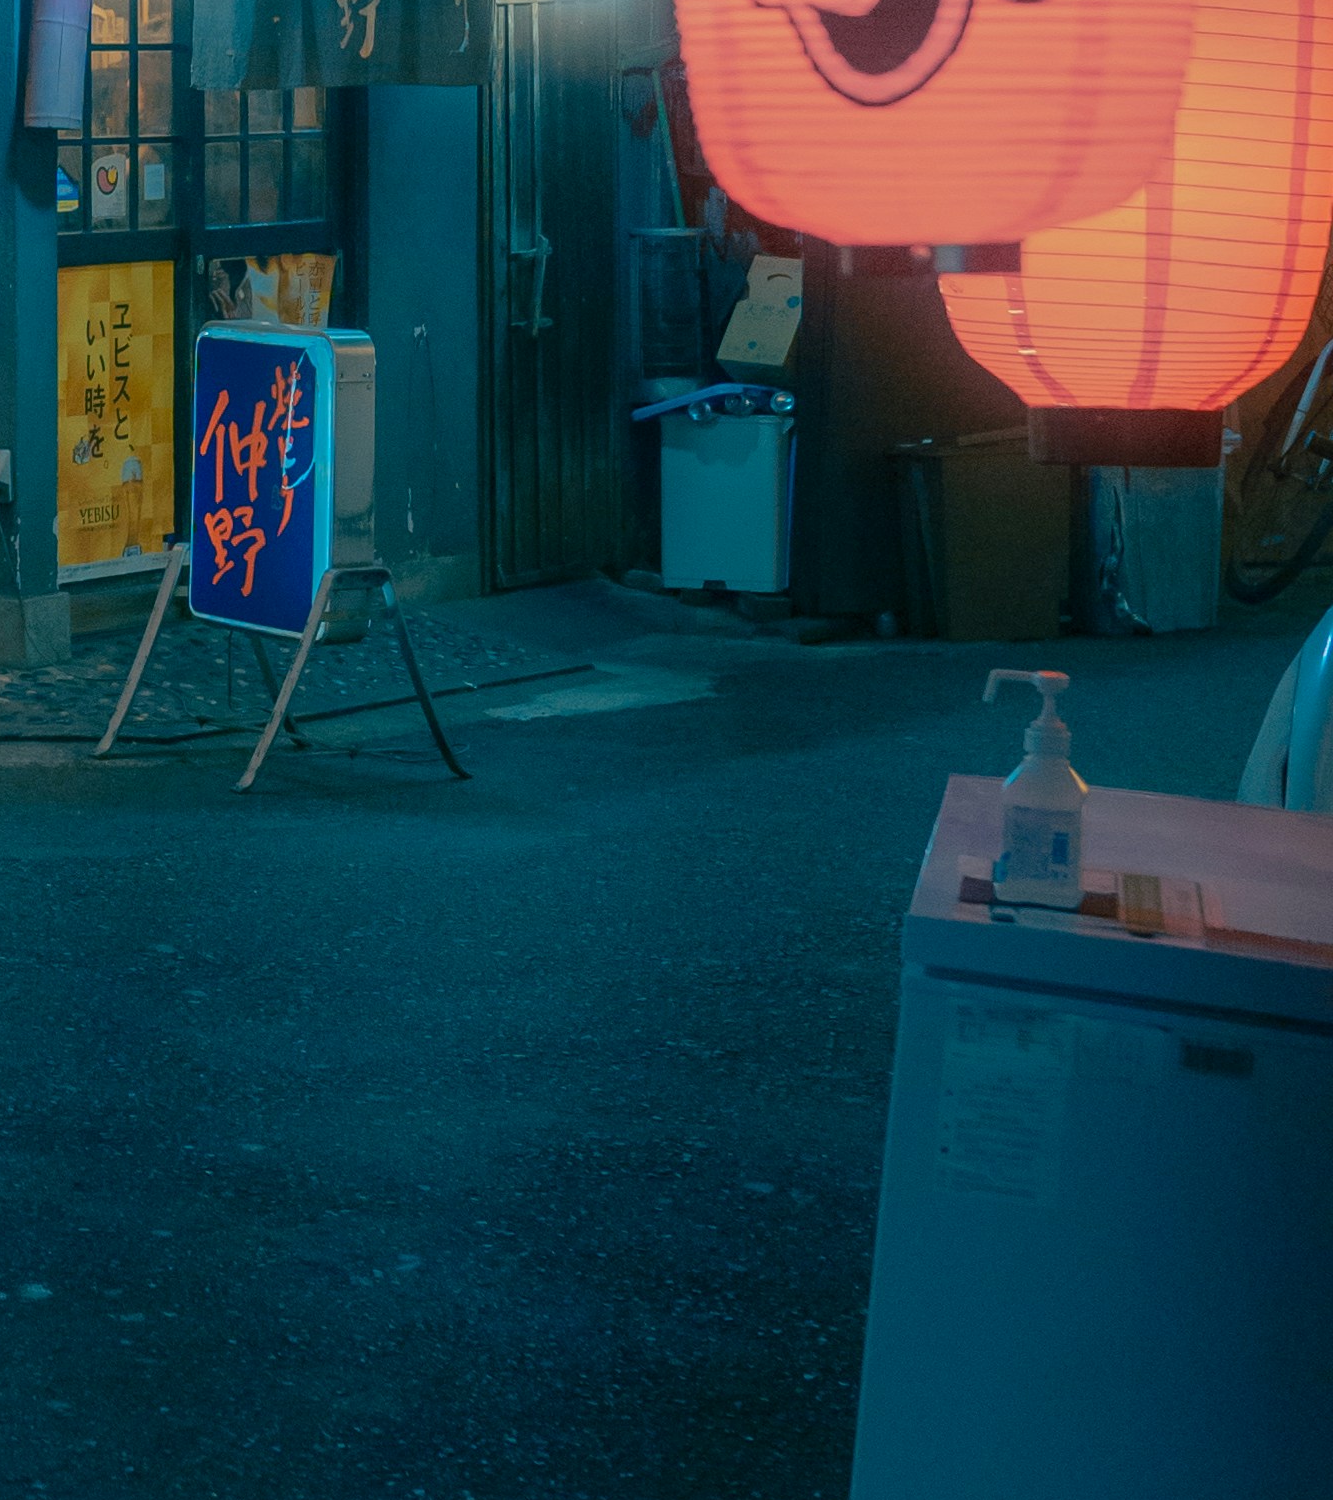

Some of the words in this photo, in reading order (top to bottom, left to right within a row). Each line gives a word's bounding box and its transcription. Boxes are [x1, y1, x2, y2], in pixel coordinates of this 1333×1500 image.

[84, 318, 111, 470] いい時を。
[79, 503, 120, 525] YEBISU
[199, 389, 268, 597] 仲野
